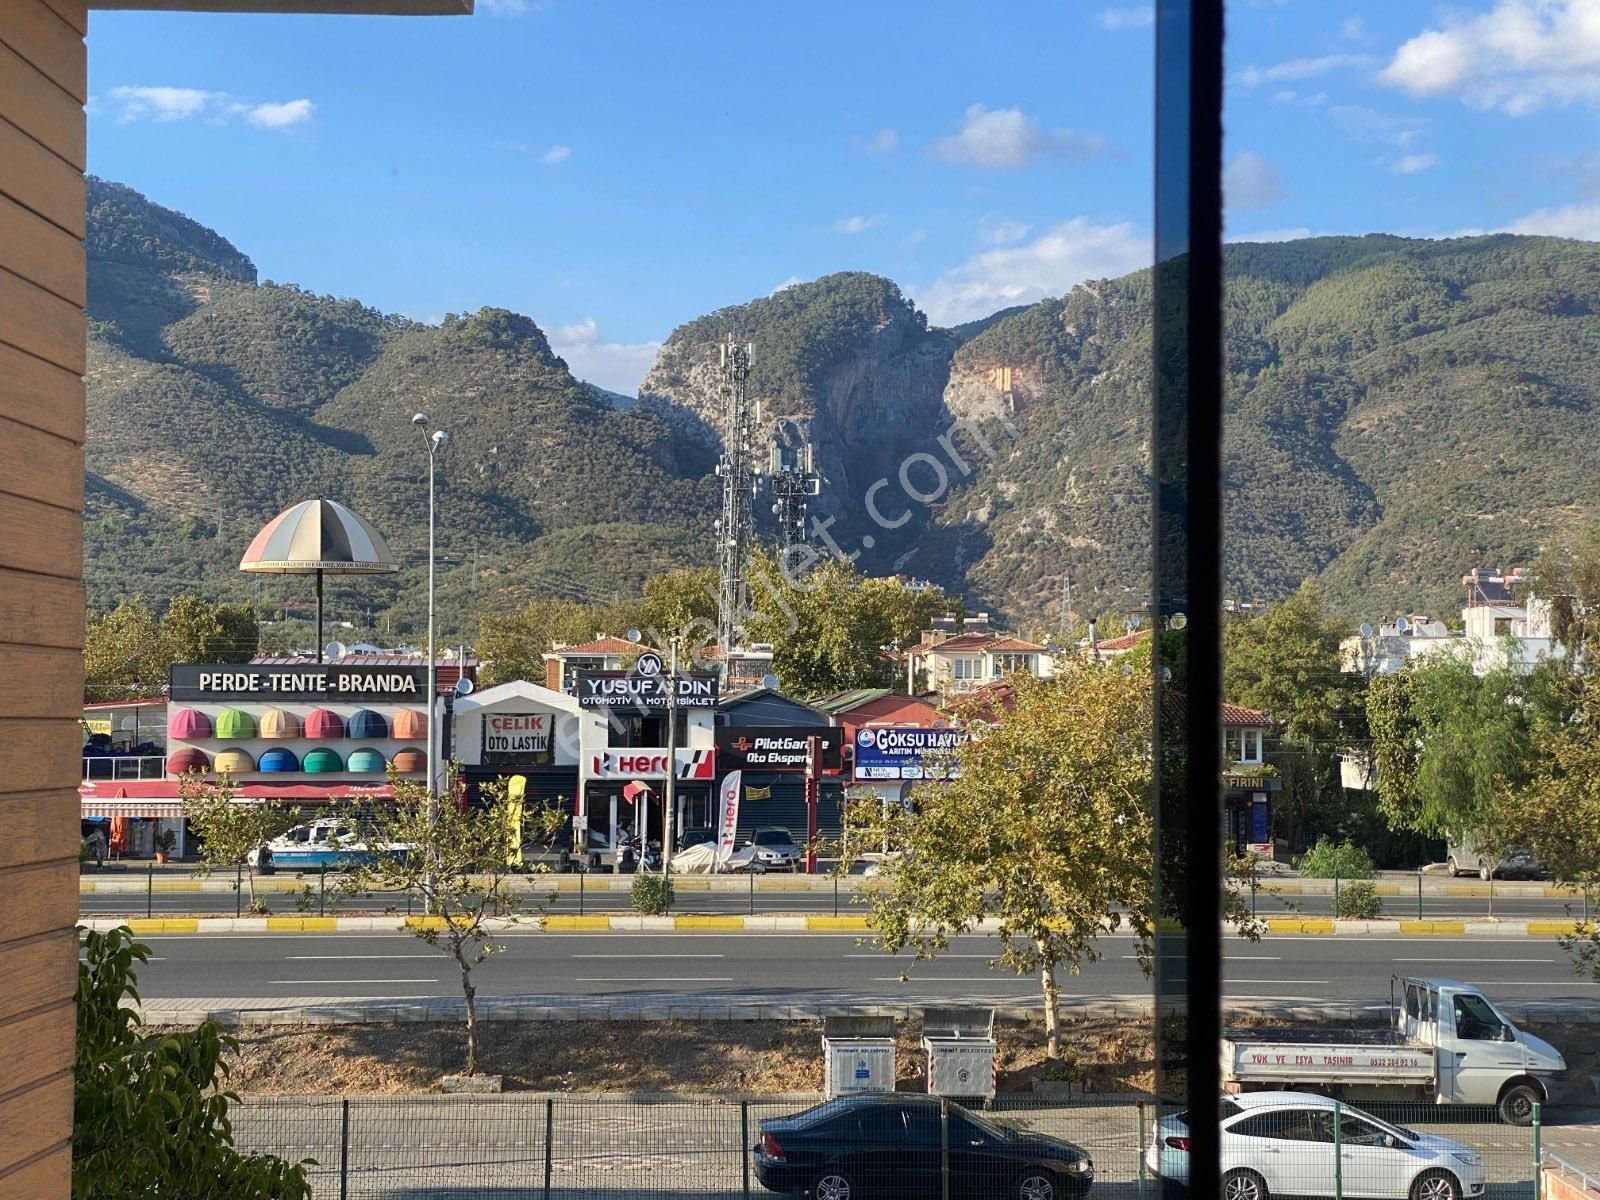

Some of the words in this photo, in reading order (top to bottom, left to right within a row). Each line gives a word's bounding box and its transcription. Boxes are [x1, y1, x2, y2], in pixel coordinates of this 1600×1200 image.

[587, 679, 653, 694] YUSUF
[655, 679, 711, 695] ADIN
[582, 695, 632, 705] OTOMOTİV
[488, 736, 509, 751] OTO
[512, 733, 548, 751] LASTİK
[754, 737, 830, 750] PilotGare
[876, 729, 925, 749] GÖKSU
[746, 752, 766, 763] Oto
[1229, 777, 1264, 788] FIRINI
[725, 789, 737, 828] Hero
[1252, 1054, 1268, 1064] YÜK
[1276, 1055, 1285, 1064] VE
[1295, 1055, 1313, 1066] EŞYA
[1323, 1056, 1354, 1067] TAŞINIR
[1370, 1058, 1386, 1066] 0532
[1400, 1059, 1408, 1067] 92
[1410, 1059, 1418, 1067] 16
